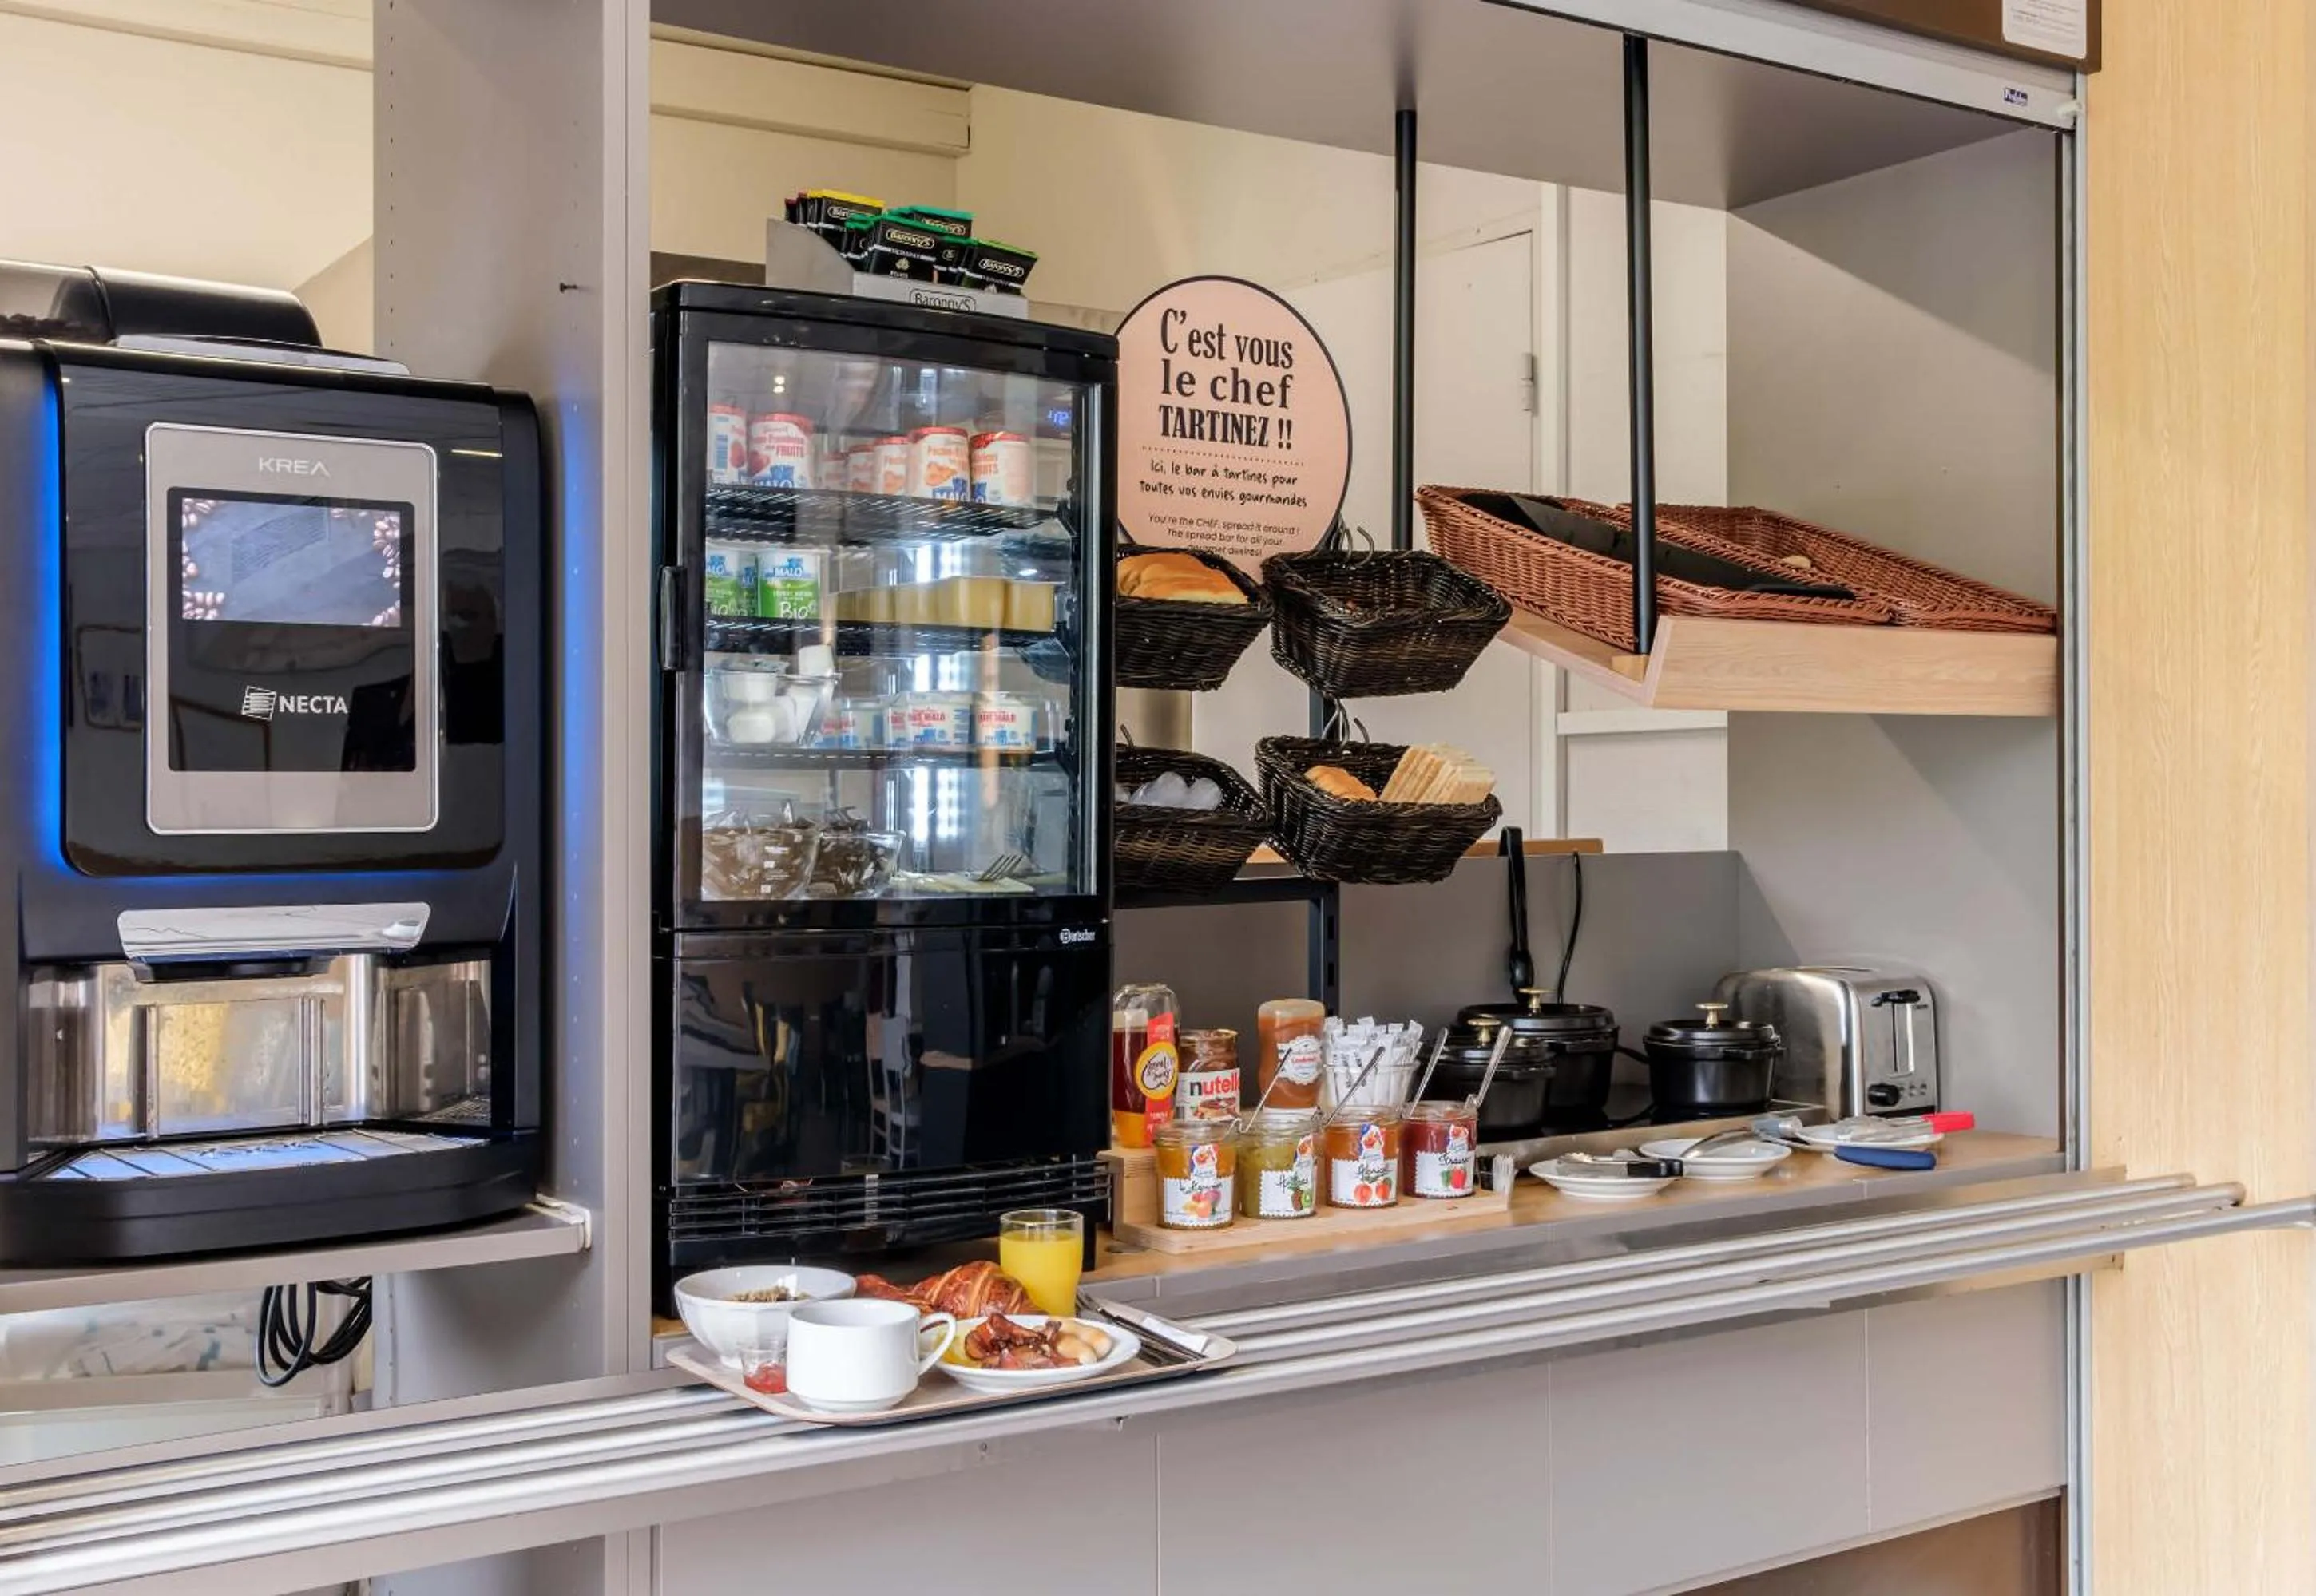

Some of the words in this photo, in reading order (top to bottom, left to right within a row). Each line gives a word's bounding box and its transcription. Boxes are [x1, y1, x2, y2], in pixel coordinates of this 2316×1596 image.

[1160, 308, 1226, 360] C'est
[1235, 335, 1293, 370] vous
[1162, 359, 1196, 398] le
[1210, 367, 1293, 409] chef
[1159, 405, 1270, 448] TARTINEZ
[259, 457, 331, 477] KREA
[1171, 461, 1180, 476] le
[1185, 462, 1206, 477] bar
[1212, 464, 1219, 477] à
[1223, 466, 1267, 485] tartines
[1271, 475, 1298, 488] pour
[1179, 485, 1196, 497] vos
[1201, 487, 1235, 501] envies
[1239, 491, 1307, 509] gourmandes
[1148, 513, 1177, 524] You're
[1179, 517, 1194, 526] the
[1222, 521, 1255, 532] spread
[1168, 528, 1183, 538] The
[1185, 529, 1217, 541] spread
[1219, 532, 1235, 542] bar
[1236, 533, 1250, 543] for
[1262, 537, 1283, 547] your
[279, 695, 348, 715] NECTA
[1189, 1071, 1239, 1096] nutell
